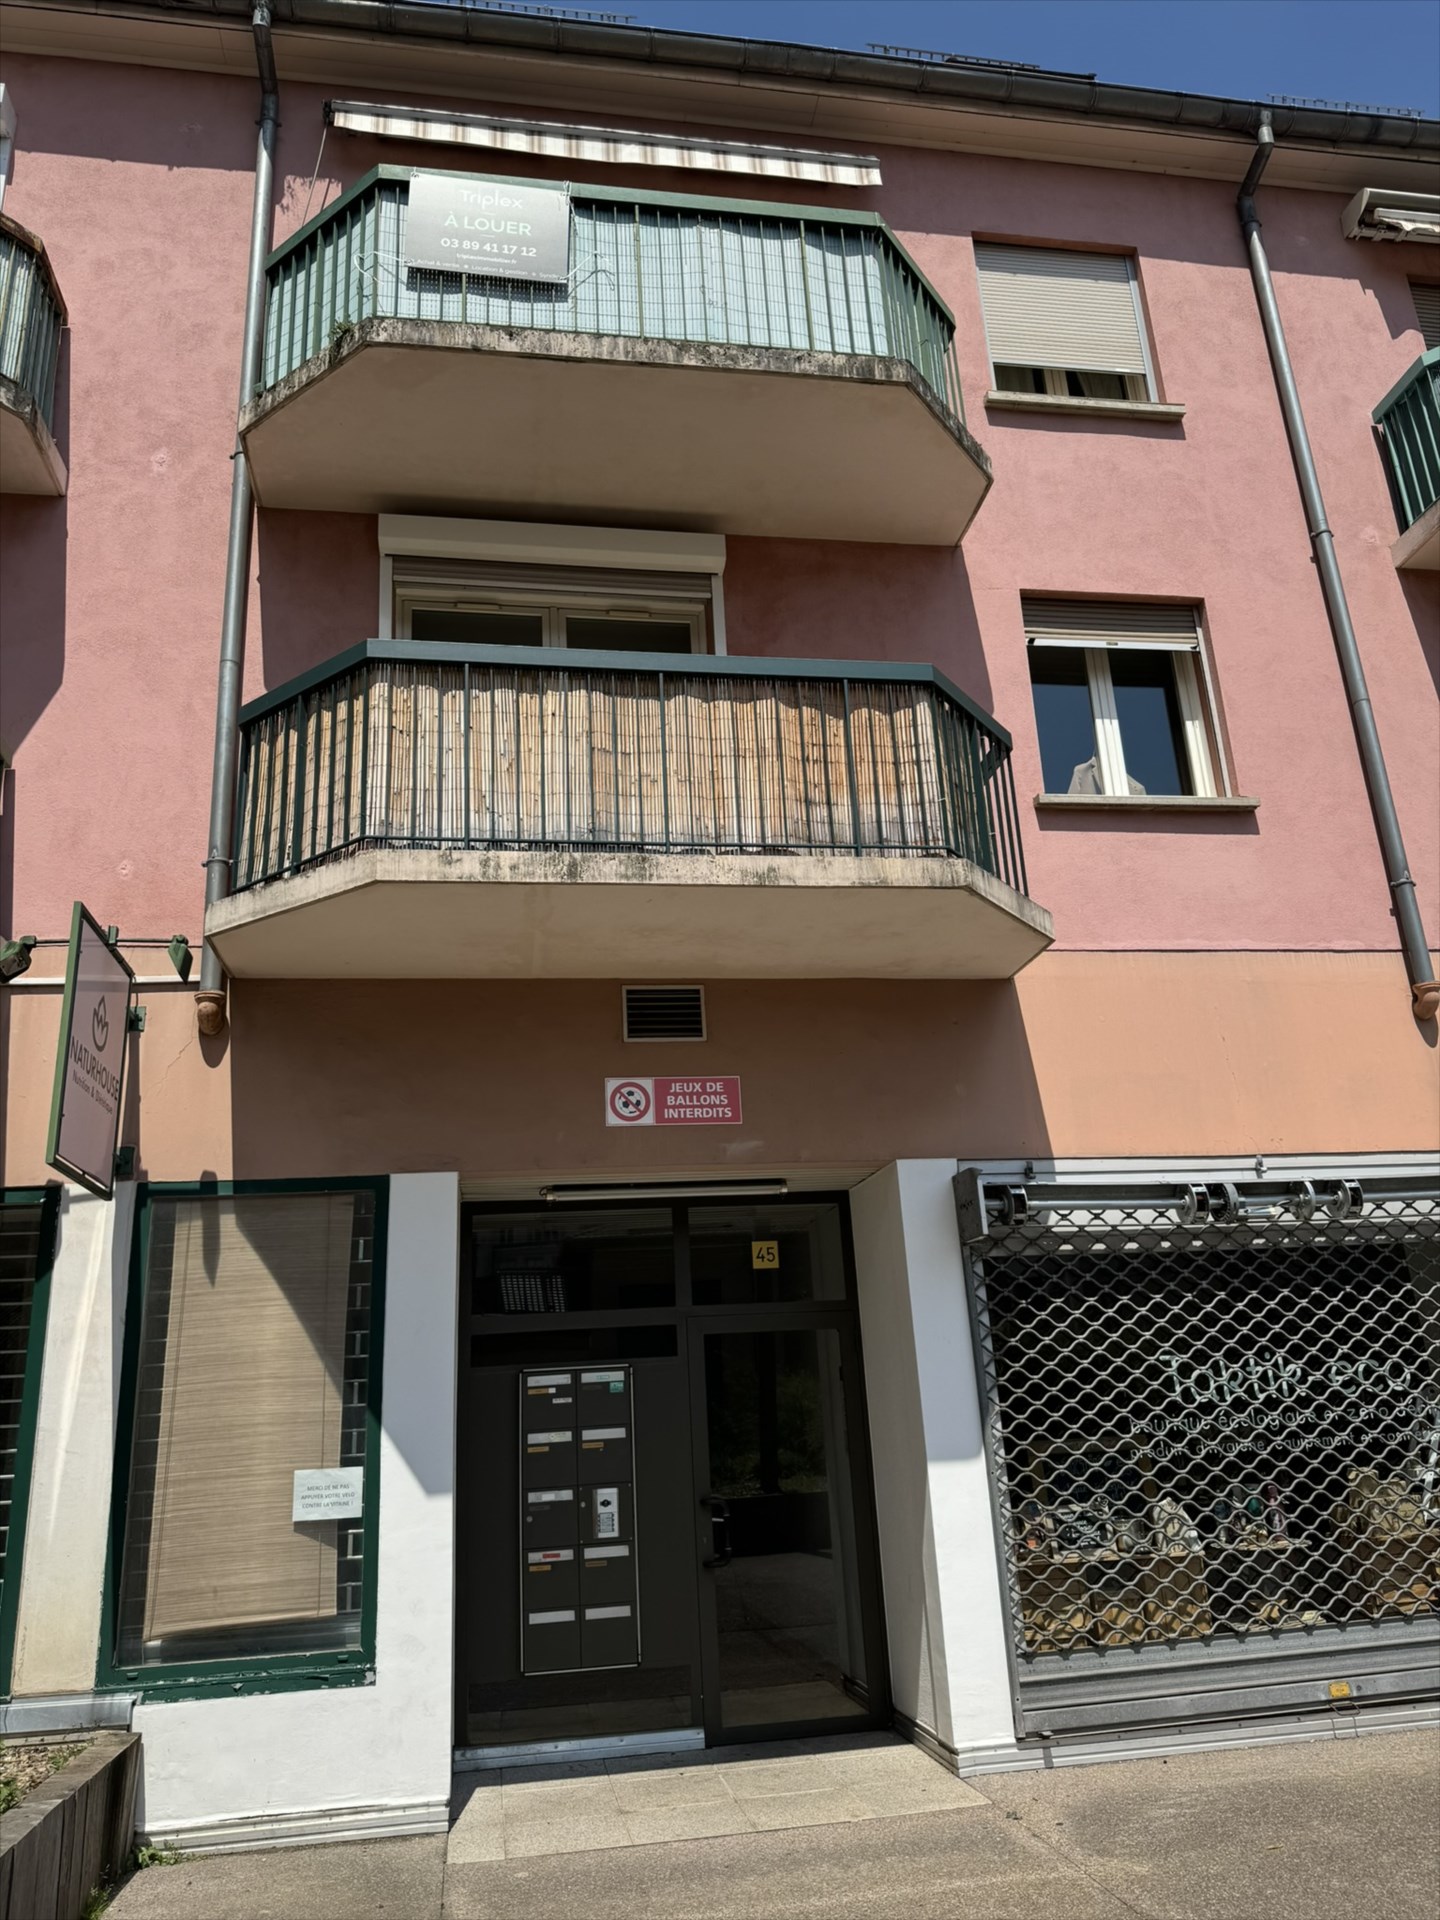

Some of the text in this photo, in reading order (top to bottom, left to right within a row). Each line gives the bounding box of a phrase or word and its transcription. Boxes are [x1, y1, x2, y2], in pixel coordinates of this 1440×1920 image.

[460, 189, 523, 210] Triplex
[444, 211, 532, 236] À LOUER
[440, 237, 537, 257] 03 89 41 17 12
[472, 265, 498, 273] Location
[70, 1035, 119, 1101] NATURHOUSE
[669, 1082, 724, 1093] JEUX DE
[667, 1094, 728, 1106] BALLONS
[664, 1107, 732, 1119] INTERDITS
[756, 1246, 776, 1263] 45
